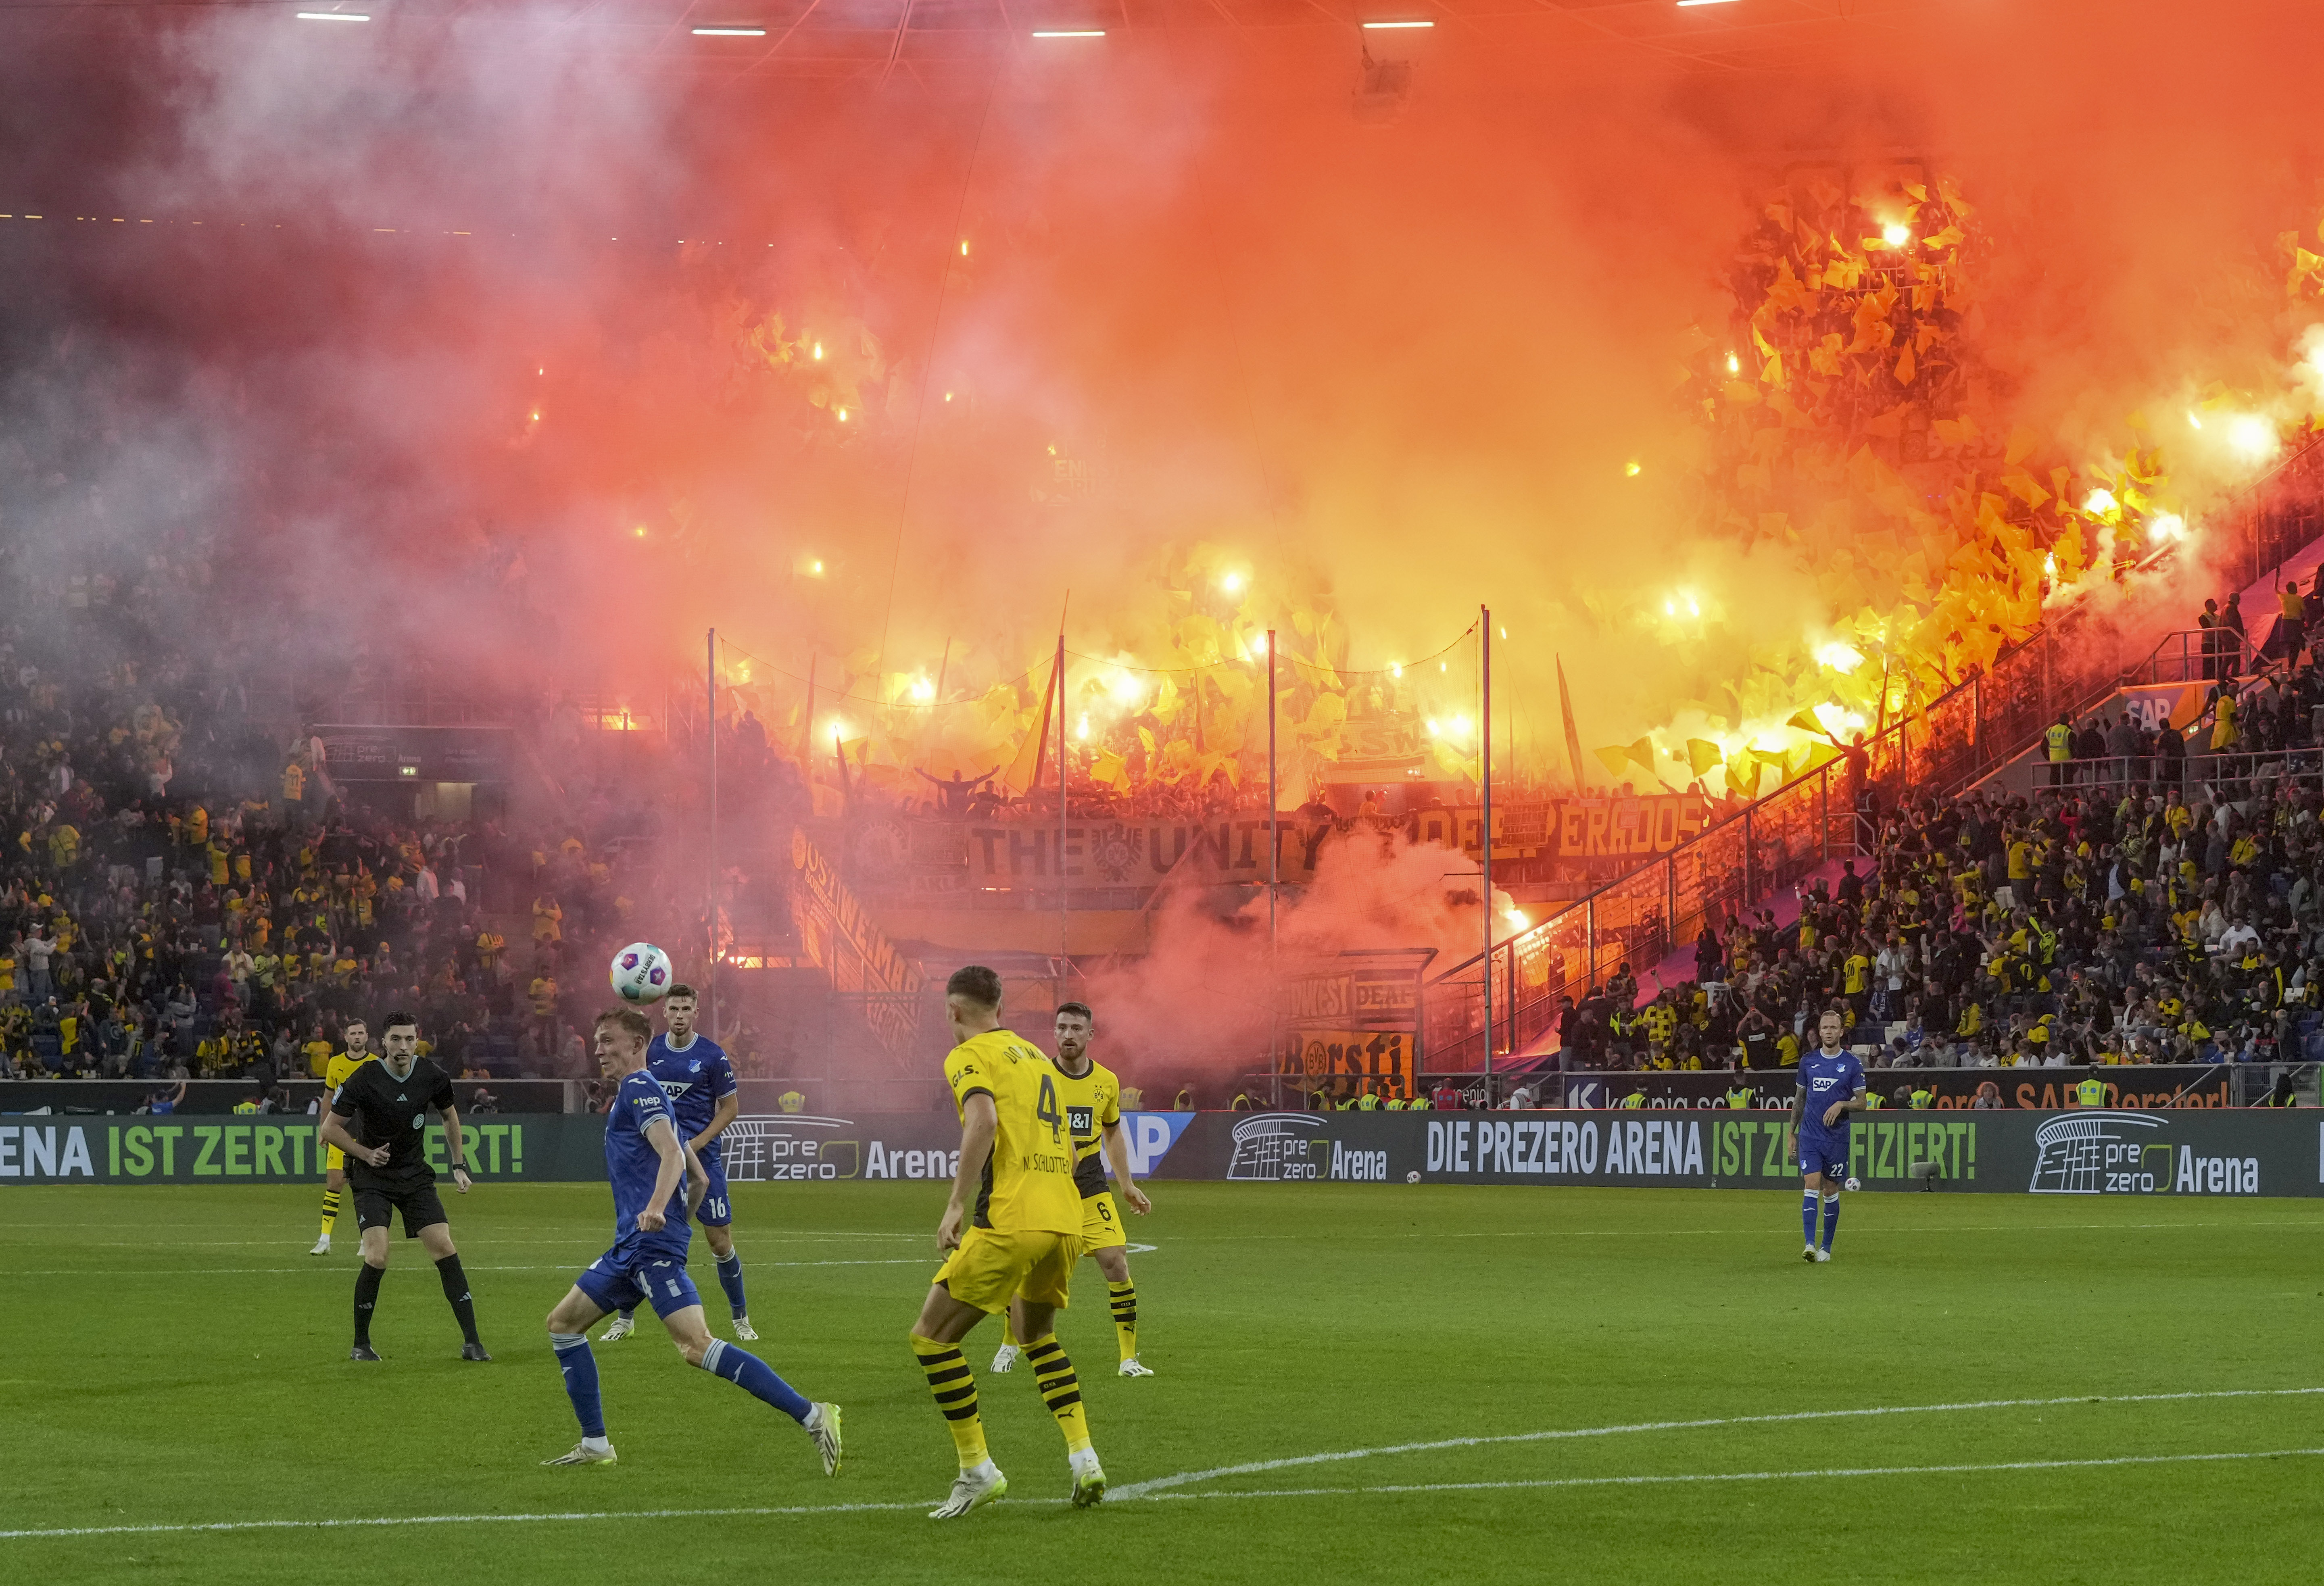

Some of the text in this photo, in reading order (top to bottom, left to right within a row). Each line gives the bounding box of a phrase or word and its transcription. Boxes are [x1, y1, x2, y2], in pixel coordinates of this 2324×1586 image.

[2126, 698, 2170, 731] SAP
[398, 753, 421, 763] Arena
[972, 827, 1084, 876] THE
[636, 954, 655, 984] DERBYSTAR
[1847, 962, 1855, 978] 26
[1309, 1046, 1324, 1069] BVB
[660, 1084, 683, 1096] AP
[1094, 1090, 1104, 1100] BVB
[1814, 1080, 1831, 1089] SAP
[639, 1096, 661, 1107] hep
[1037, 1073, 1062, 1144] 4
[1067, 1113, 1089, 1128] 1&1
[108, 1125, 183, 1176] IST
[772, 1139, 816, 1161] pre
[1284, 1138, 1308, 1159] pre
[1427, 1121, 1469, 1174] DIE
[1477, 1121, 1597, 1174] PREZERO
[1604, 1121, 1704, 1175] ARENA
[1713, 1121, 1757, 1176] IST
[2105, 1144, 2139, 1169] pre
[1284, 1161, 1316, 1180] zero
[1332, 1140, 1387, 1180] Arena
[1829, 1163, 1843, 1177] 22
[2177, 1145, 2258, 1194] Arena
[773, 1163, 836, 1180] zero
[2105, 1172, 2153, 1192] zero
[709, 1196, 726, 1219] 16
[1097, 1202, 1111, 1221] 6
